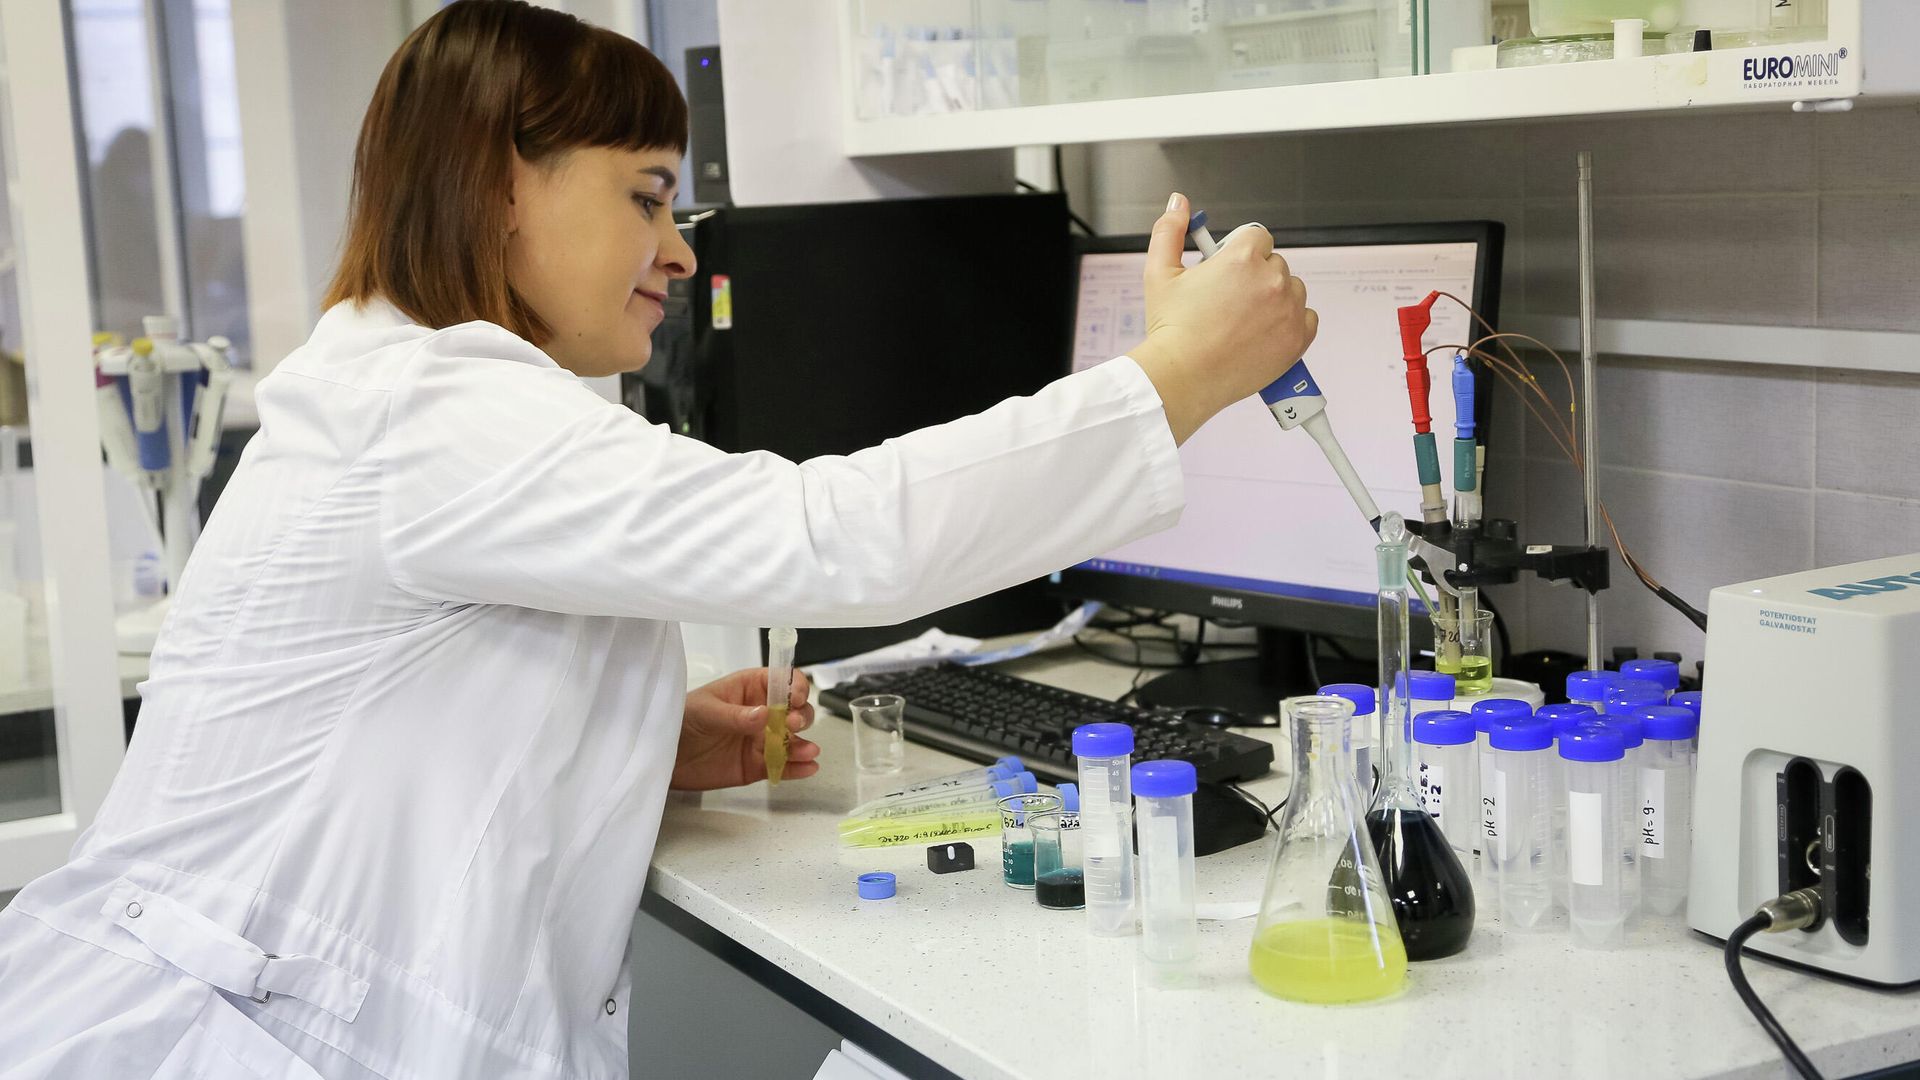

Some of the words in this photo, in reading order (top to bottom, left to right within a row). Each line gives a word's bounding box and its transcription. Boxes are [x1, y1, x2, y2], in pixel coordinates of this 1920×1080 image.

[1743, 80, 1803, 89] ЛАБОРАТОРНАЯ
[1759, 609, 1817, 625] POTENTIOSTAT
[1759, 619, 1817, 634] GALVANOSTAT
